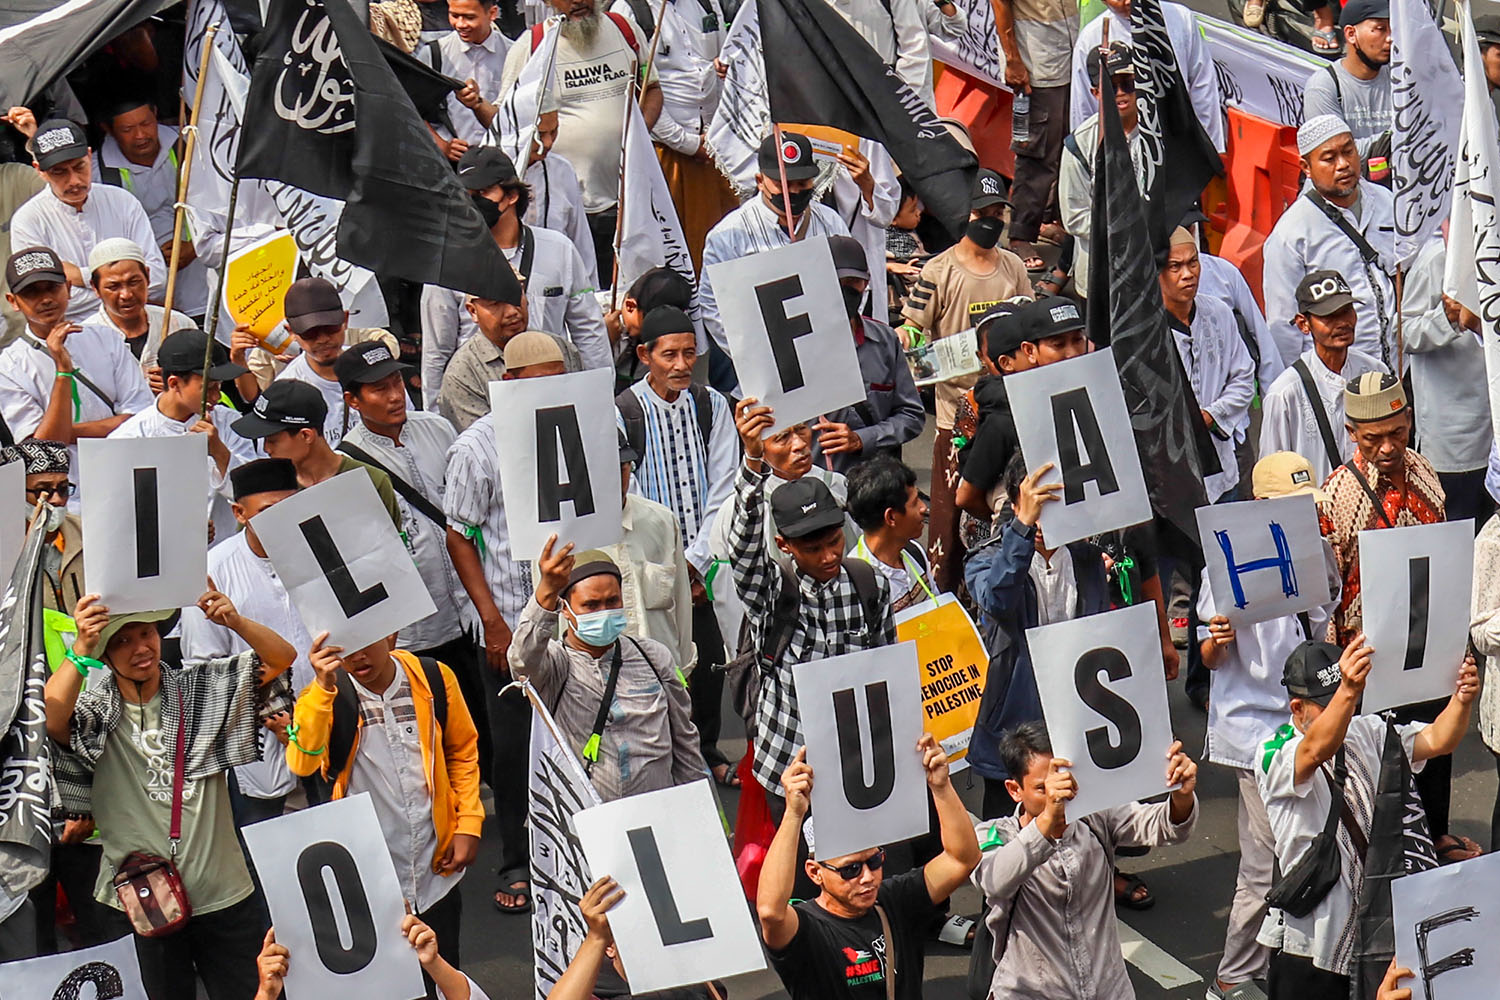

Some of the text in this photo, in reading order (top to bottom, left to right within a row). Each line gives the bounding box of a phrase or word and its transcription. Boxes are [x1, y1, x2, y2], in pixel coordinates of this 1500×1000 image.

[564, 63, 612, 81] ALLIWA
[565, 76, 601, 89] ISLAMIC
[755, 274, 813, 393] F
[536, 405, 595, 522] A
[1050, 387, 1121, 505] A
[134, 468, 159, 578] I
[299, 513, 390, 620] L
[1216, 524, 1293, 608] H
[925, 653, 955, 678] STOP
[1403, 557, 1429, 671] I
[924, 682, 984, 720] PALESTINE
[967, 663, 981, 683] IN
[1075, 647, 1142, 769] S
[832, 681, 895, 810] U
[285, 842, 377, 976] O
[626, 826, 714, 946] L
[845, 959, 880, 978] #SAVE
